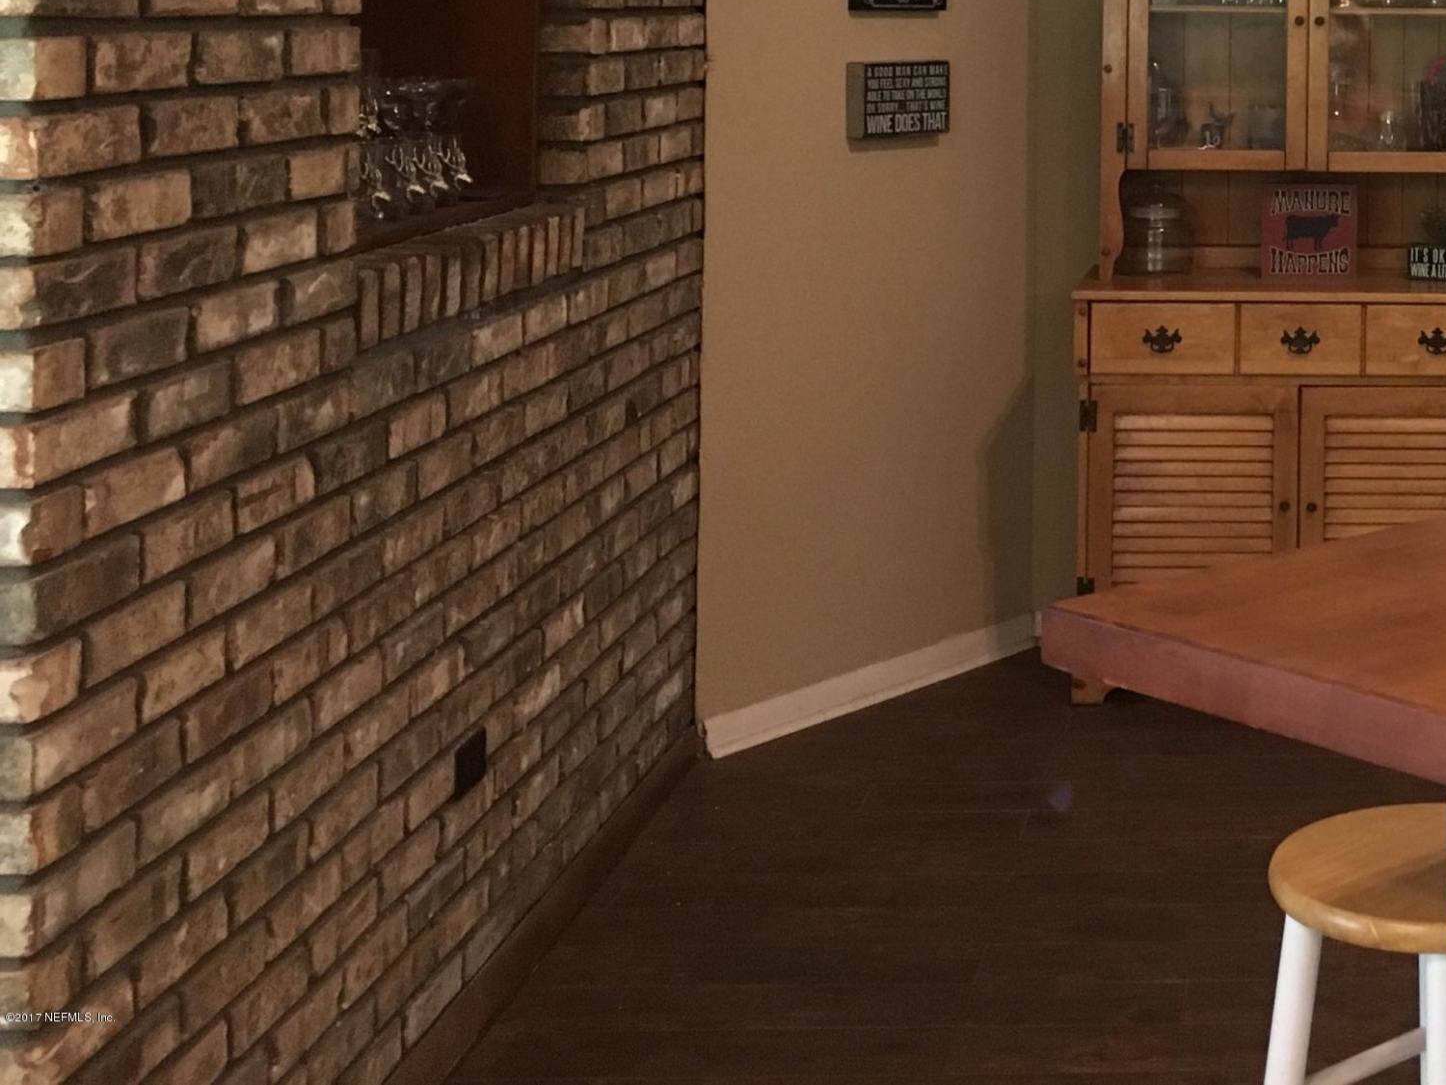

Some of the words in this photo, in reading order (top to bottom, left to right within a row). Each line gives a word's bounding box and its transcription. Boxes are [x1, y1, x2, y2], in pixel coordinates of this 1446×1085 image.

[867, 114, 893, 134] WINE
[895, 113, 920, 132] DOES
[922, 112, 947, 130] THAT
[1271, 189, 1351, 215] MANURE
[1270, 246, 1350, 274] HAPPENS
[1410, 247, 1429, 263] IT'S
[1432, 248, 1446, 264] OK
[1410, 262, 1430, 277] WINE
[1431, 264, 1437, 278] A
